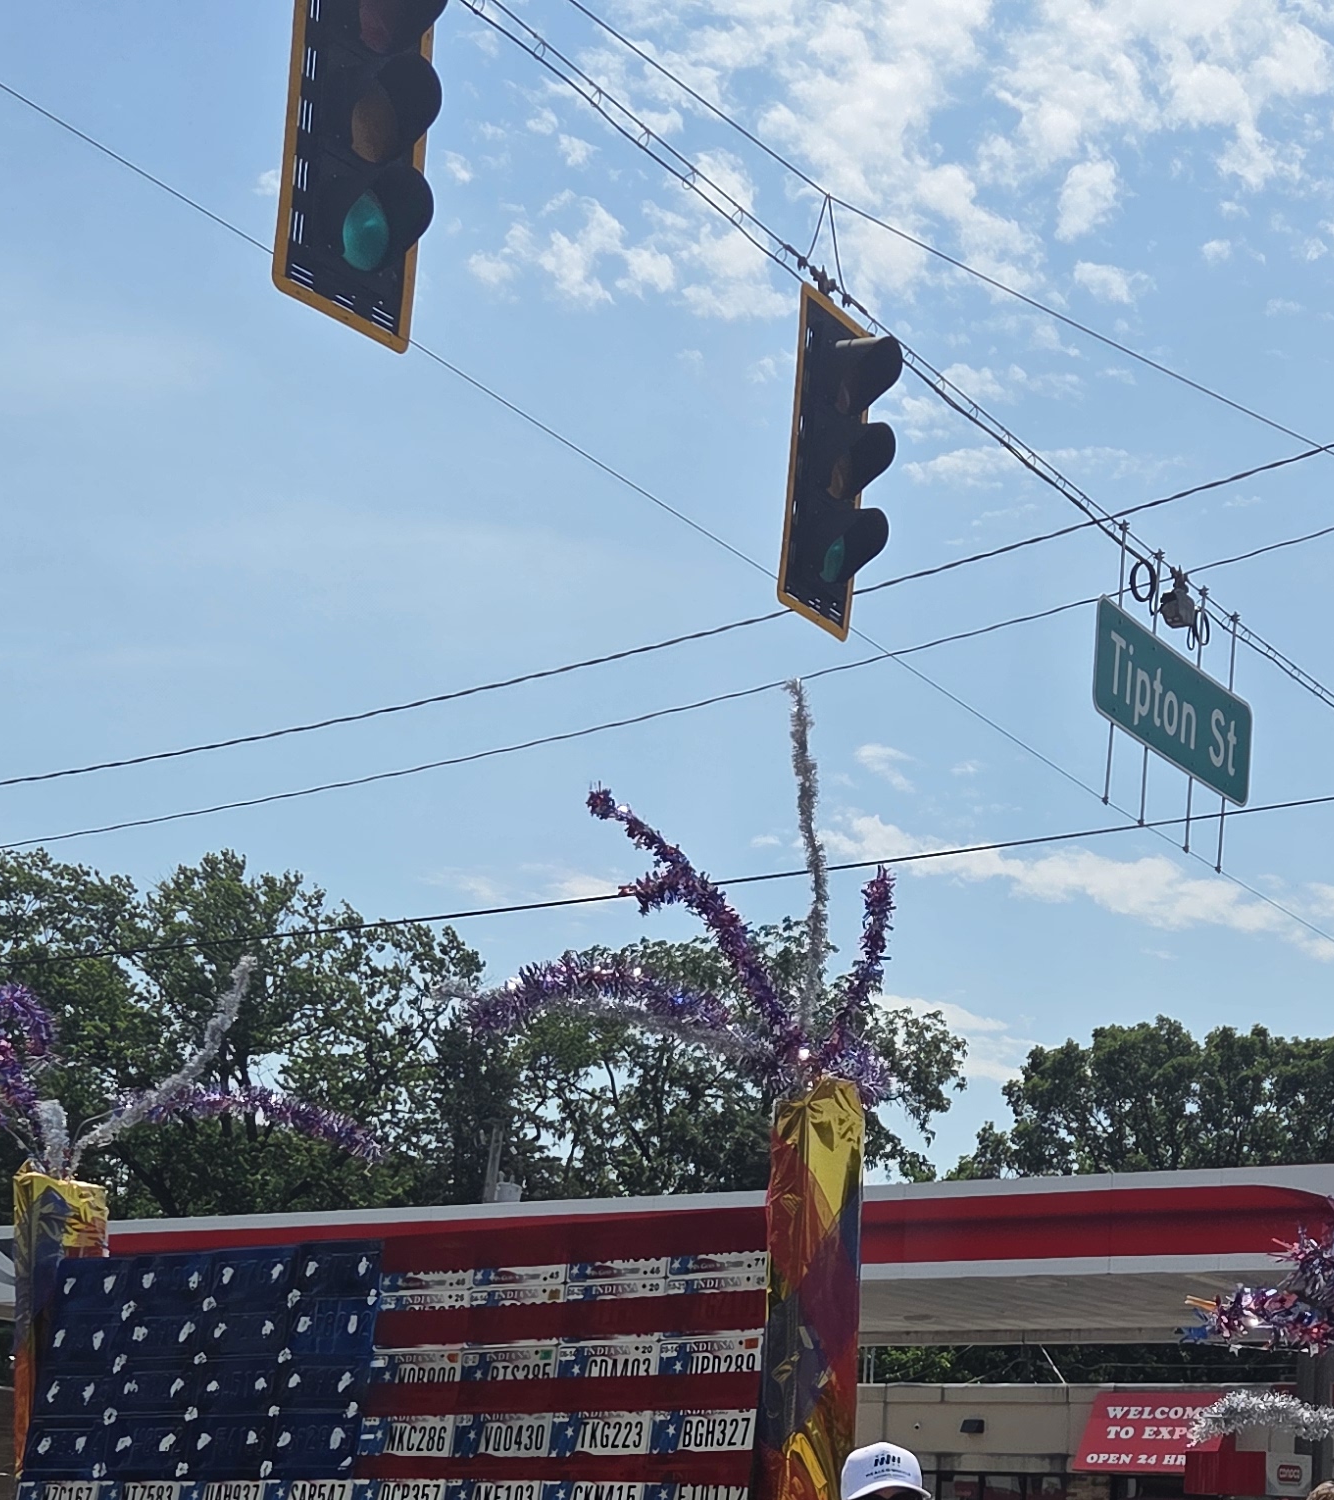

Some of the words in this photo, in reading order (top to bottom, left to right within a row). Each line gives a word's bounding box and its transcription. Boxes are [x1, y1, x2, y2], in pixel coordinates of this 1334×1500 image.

[1110, 630, 1197, 751] Tipton
[1208, 708, 1238, 777] St
[754, 1257, 765, 1267] 71
[591, 1282, 638, 1296] INDIANA
[693, 1275, 742, 1289] INDIANA
[402, 1294, 445, 1305] INDIANA
[583, 1344, 631, 1356] INDIANA
[641, 1345, 652, 1353] 20
[686, 1340, 735, 1352] INDIANA
[1106, 1406, 1204, 1421] WELCOM
[387, 1425, 447, 1452] NKC286
[580, 1421, 643, 1449] TKG223
[682, 1417, 751, 1448] BGH327
[1106, 1426, 1135, 1440] TO
[1085, 1453, 1133, 1465] OPEN
[1136, 1454, 1156, 1465] 24
